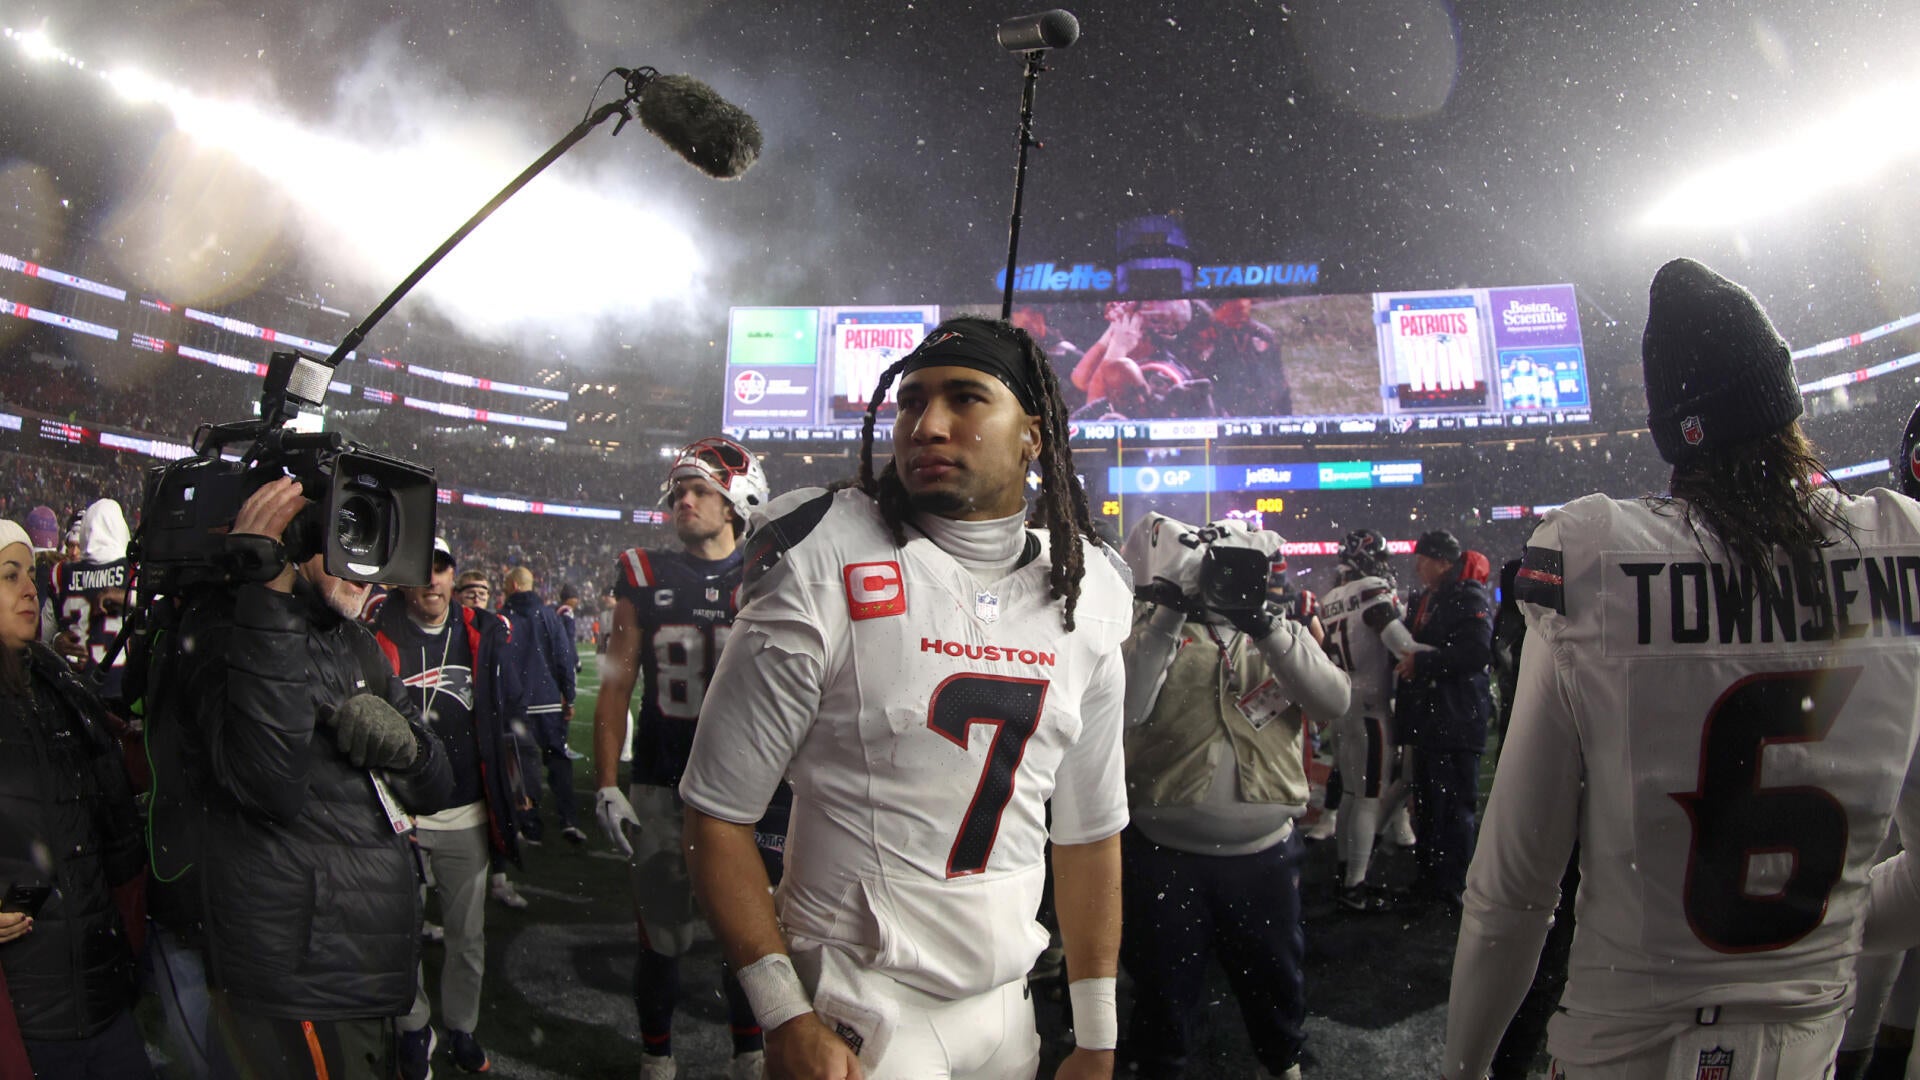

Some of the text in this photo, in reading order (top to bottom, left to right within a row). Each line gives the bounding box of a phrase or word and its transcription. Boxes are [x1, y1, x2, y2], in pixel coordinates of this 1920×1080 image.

[996, 263, 1319, 291] Gillette STADIUM
[1503, 306, 1568, 325] Scientific
[1510, 300, 1550, 314] Boston
[1400, 313, 1468, 336] PATRIOTS
[845, 328, 913, 349] PATRIOTS
[1402, 335, 1475, 391] WIN
[1163, 470, 1191, 486] GP
[1245, 467, 1292, 485] jetBlue
[1280, 542, 1321, 554] TOYOTA
[69, 566, 125, 591] JENNINGS
[850, 565, 899, 603] C
[654, 589, 674, 606] C
[1619, 556, 1920, 644] TOWNSEND
[920, 637, 1055, 667] HOUSTON
[653, 623, 733, 719] 8
[926, 671, 1050, 879] 7
[1667, 665, 1864, 955] 6
